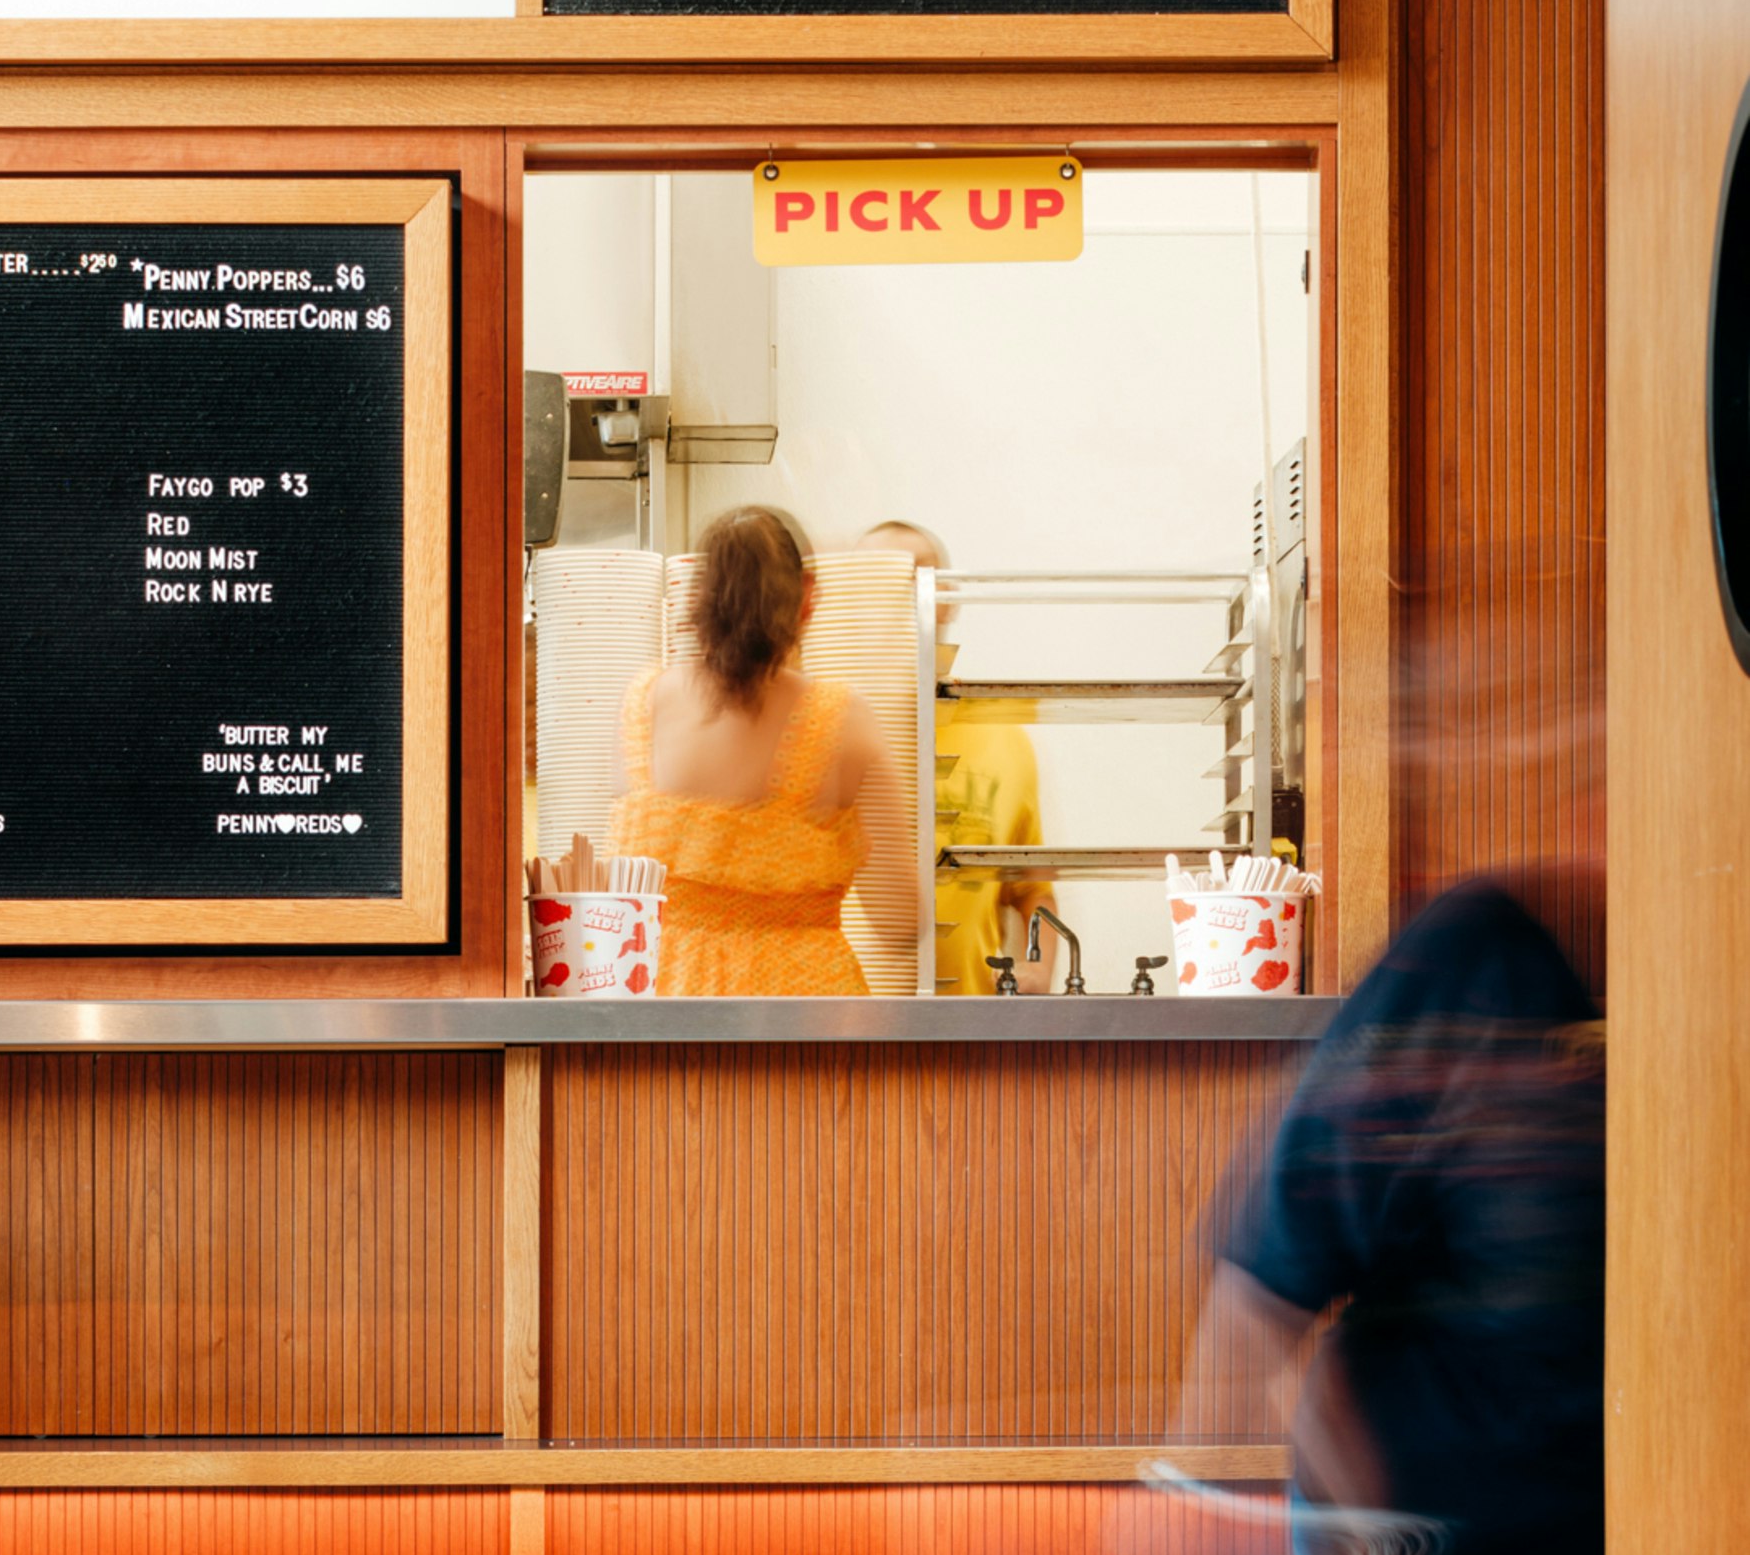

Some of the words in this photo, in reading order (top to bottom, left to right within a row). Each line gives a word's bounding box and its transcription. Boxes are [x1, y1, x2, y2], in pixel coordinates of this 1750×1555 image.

[775, 190, 941, 232] PICK
[969, 189, 1064, 230] UP
[336, 263, 365, 290] $6
[280, 472, 308, 497] $3
[302, 726, 328, 745] MY
[203, 753, 255, 773] BUNS
[278, 754, 324, 773] CALL
[336, 754, 363, 773] ME
